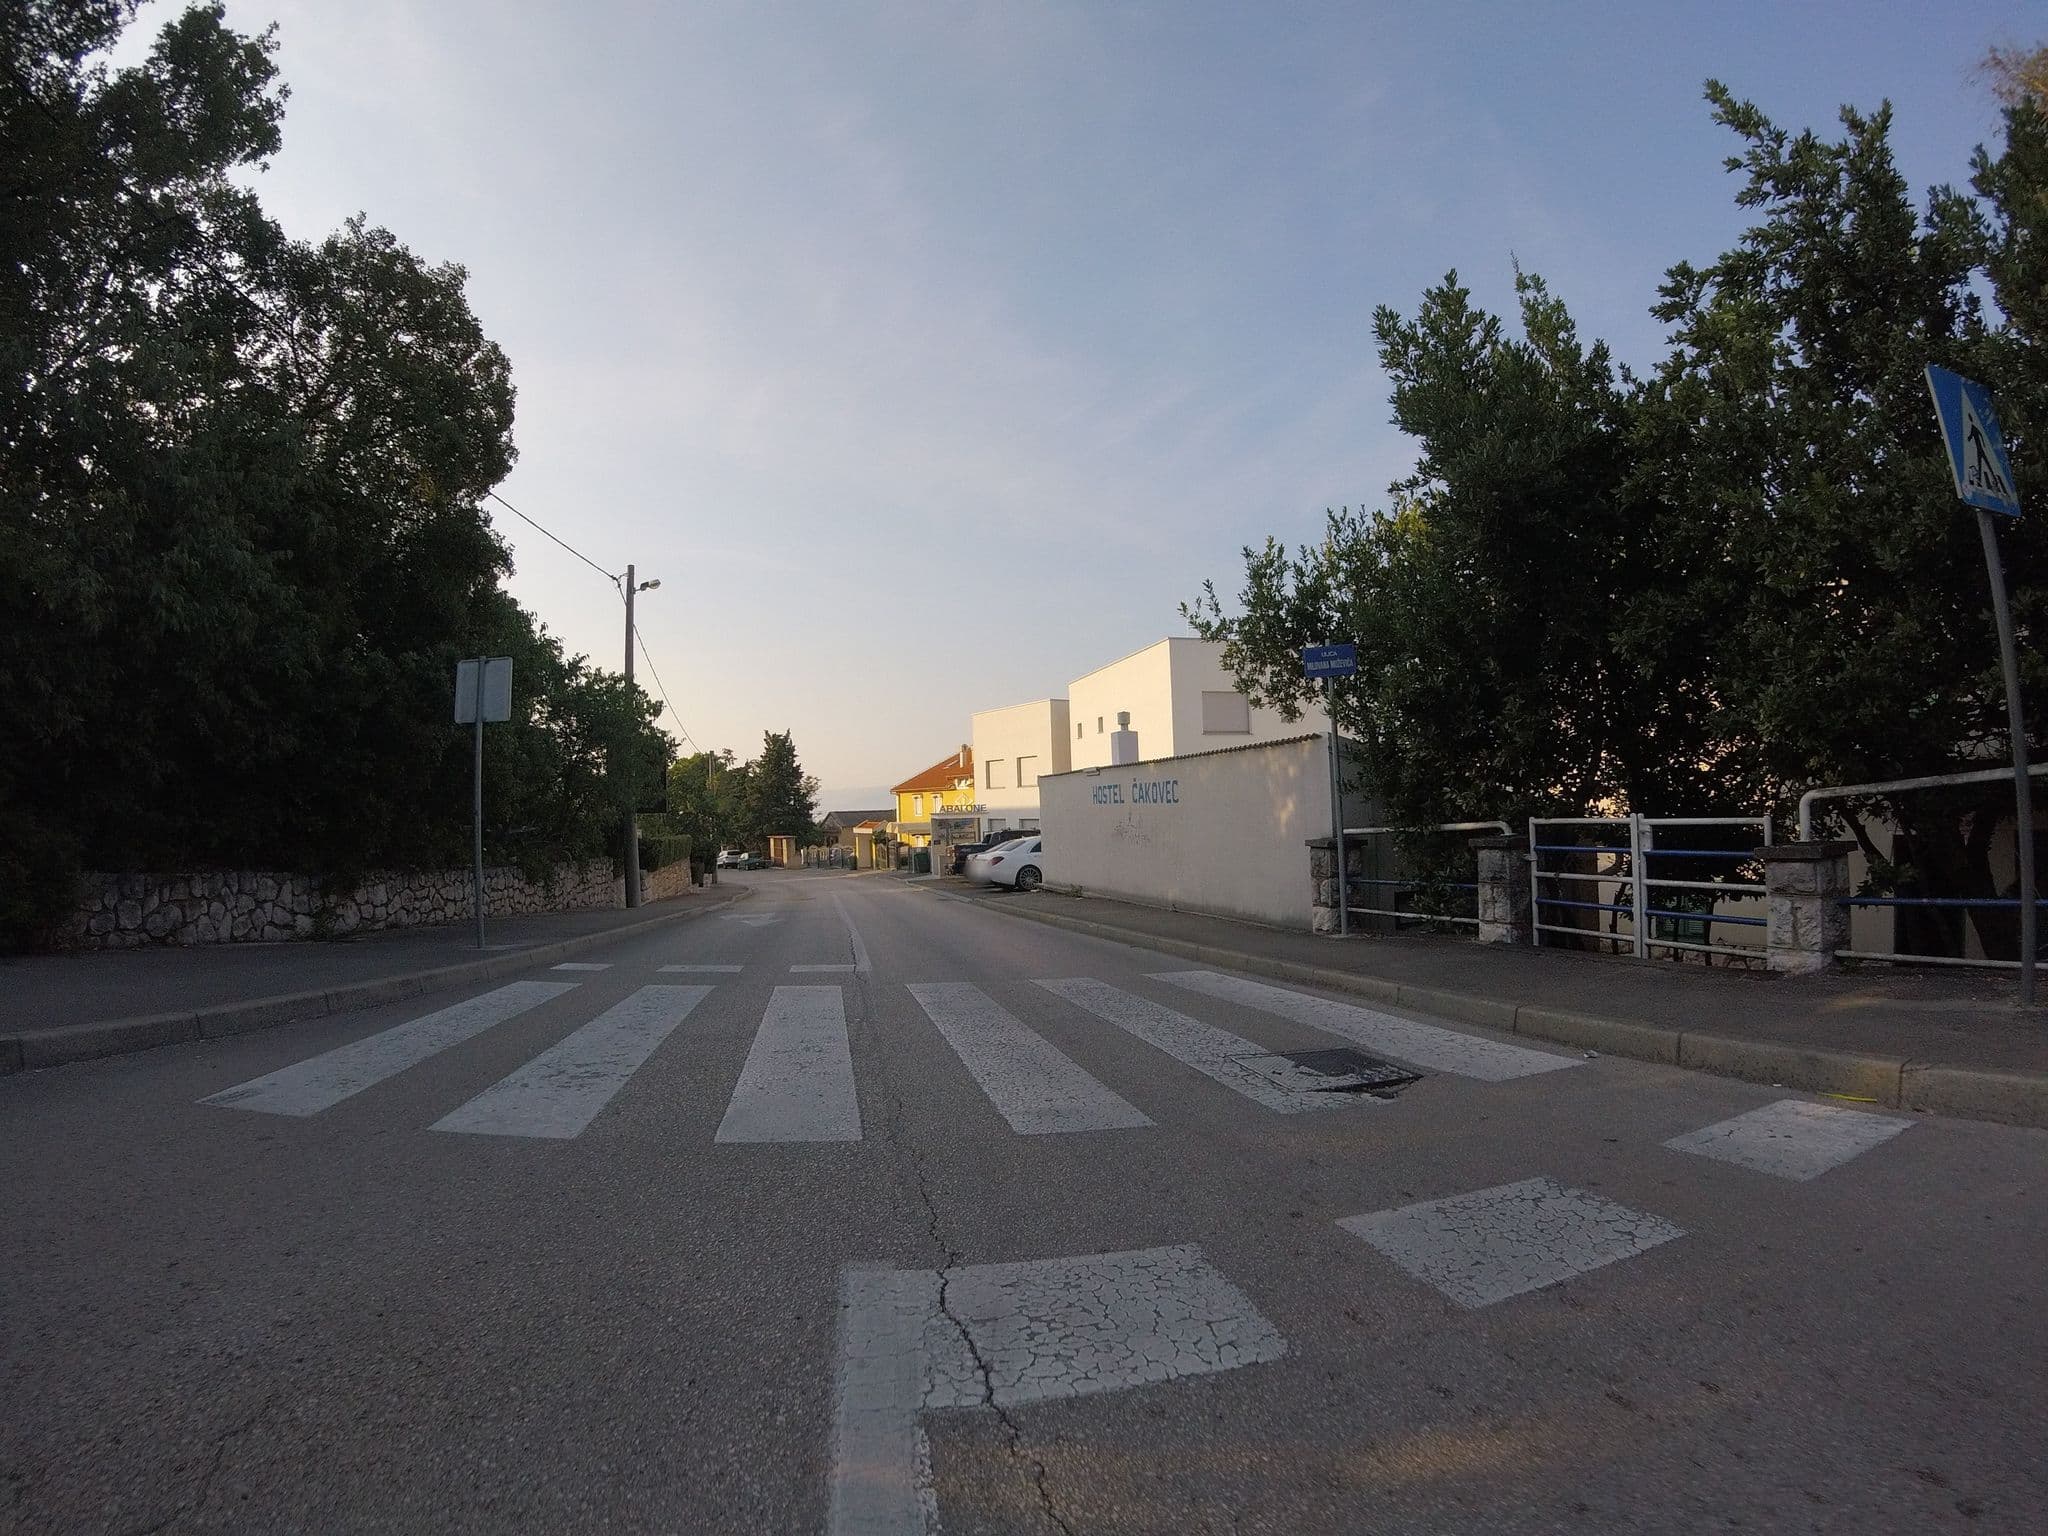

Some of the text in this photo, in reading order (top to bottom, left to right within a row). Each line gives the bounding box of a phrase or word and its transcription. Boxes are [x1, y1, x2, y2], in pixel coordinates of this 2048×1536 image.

[1092, 777, 1179, 804] HOSTEL ČAKOVEC
[940, 804, 988, 813] ABALONE
